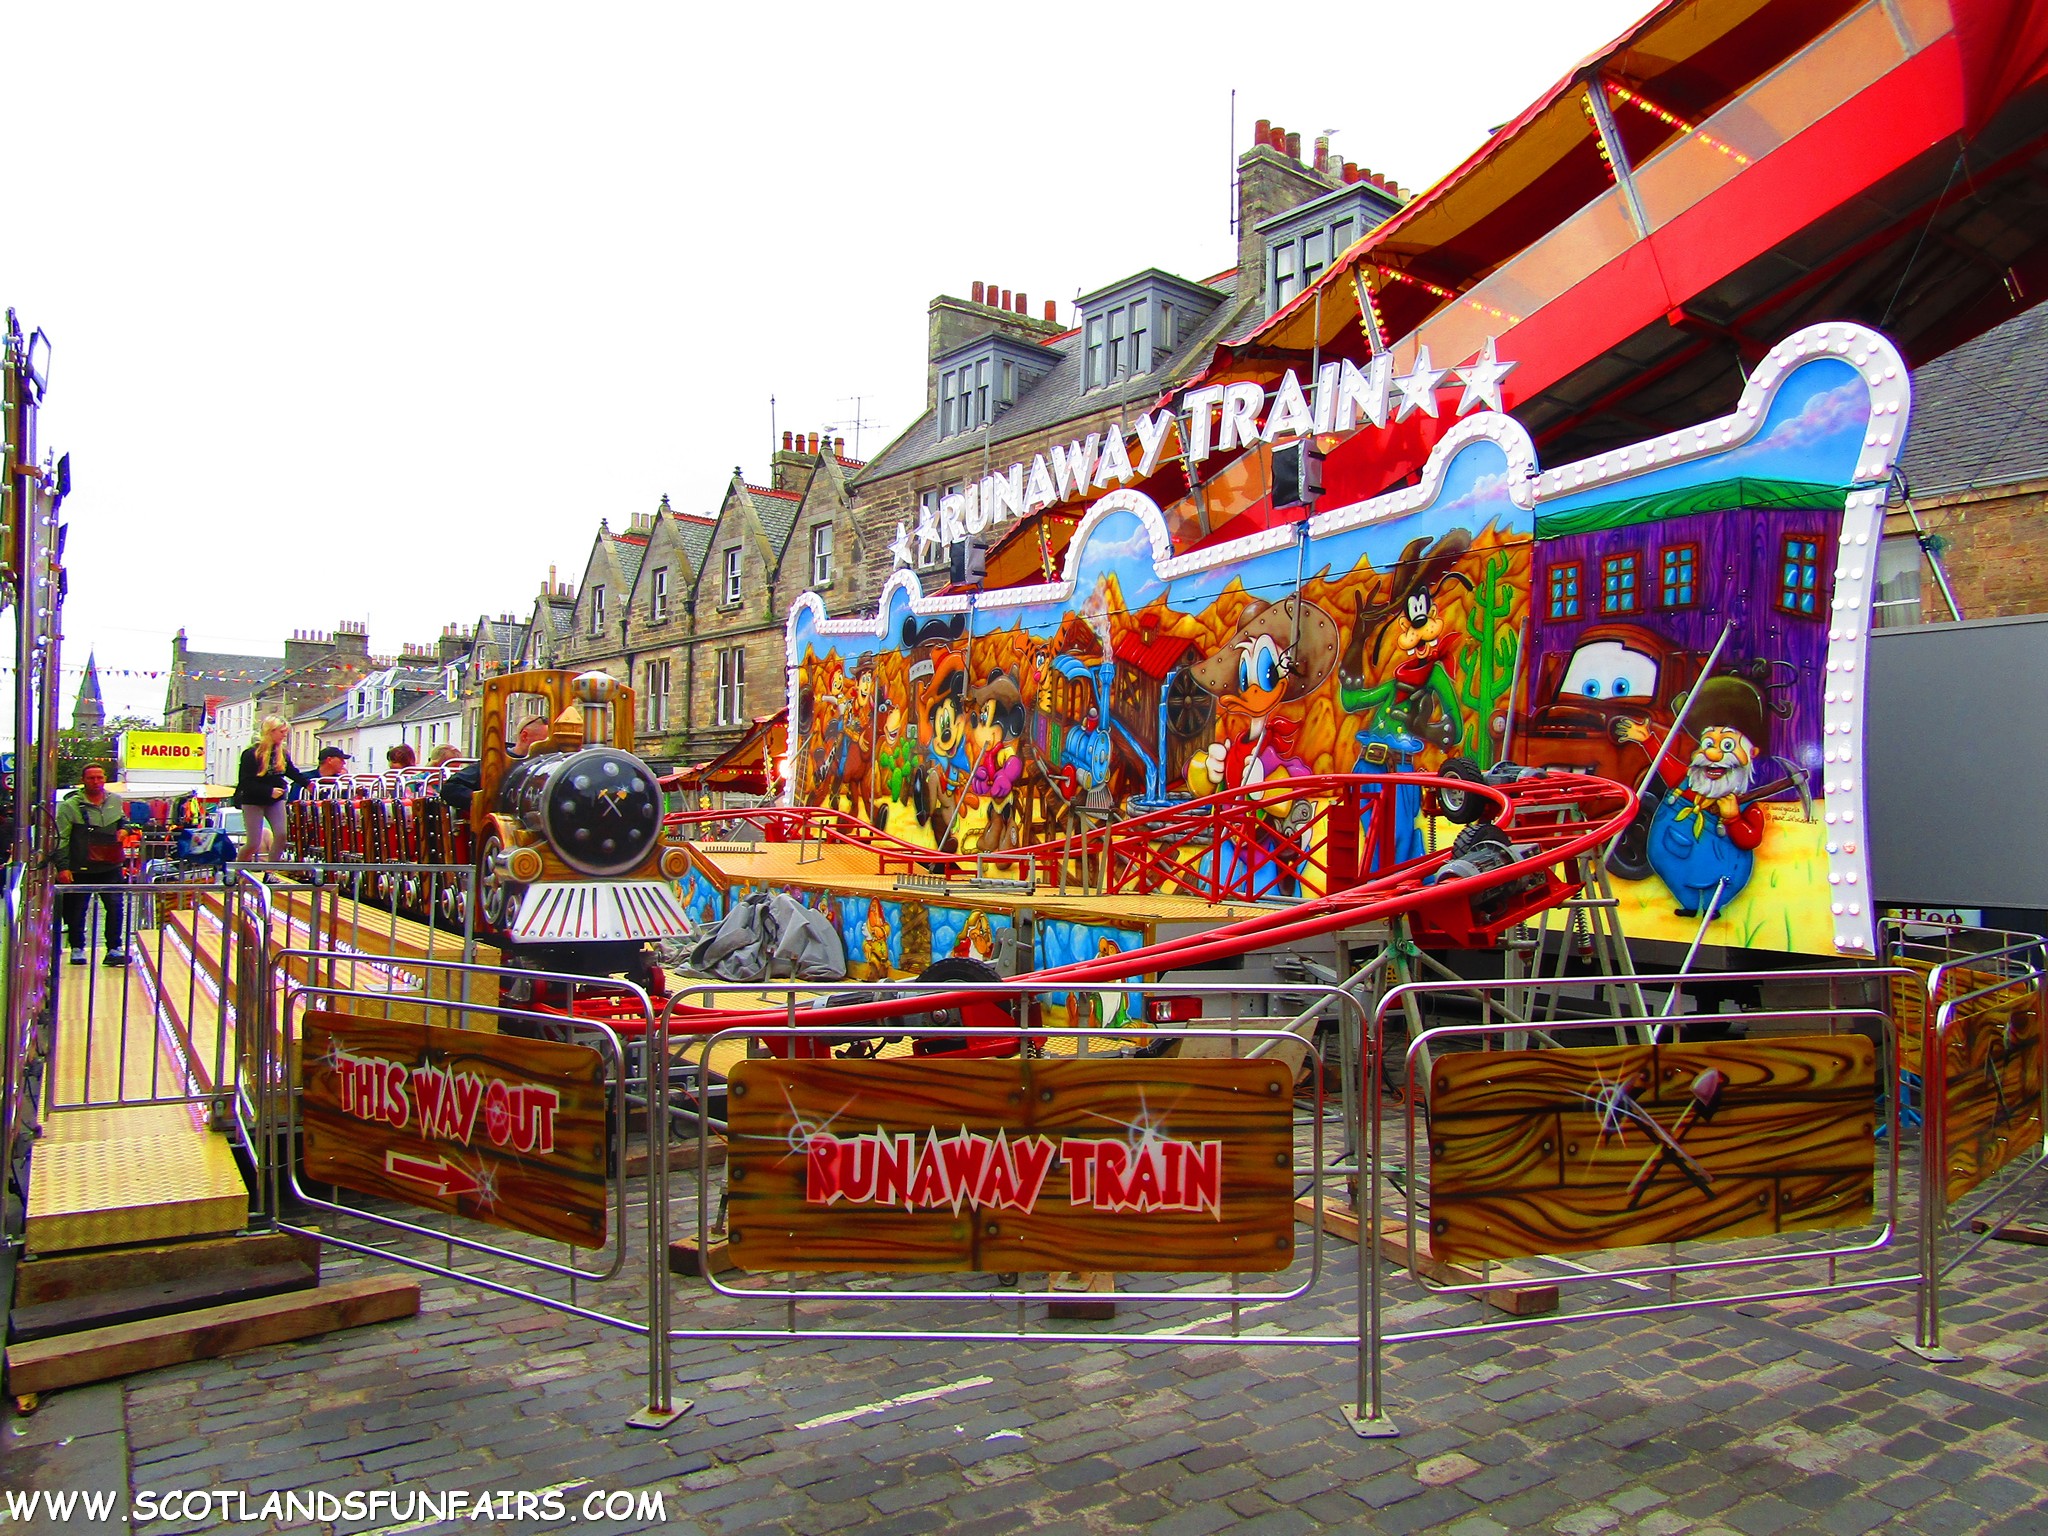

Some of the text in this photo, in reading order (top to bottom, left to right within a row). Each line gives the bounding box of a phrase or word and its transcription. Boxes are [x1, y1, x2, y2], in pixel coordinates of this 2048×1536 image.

[940, 351, 1393, 547] RUNAWAY TRAIN
[141, 745, 190, 757] HARIBO
[336, 1052, 560, 1154] THIS WAY OUT
[806, 1123, 1222, 1222] RUNAWAY TRAIN
